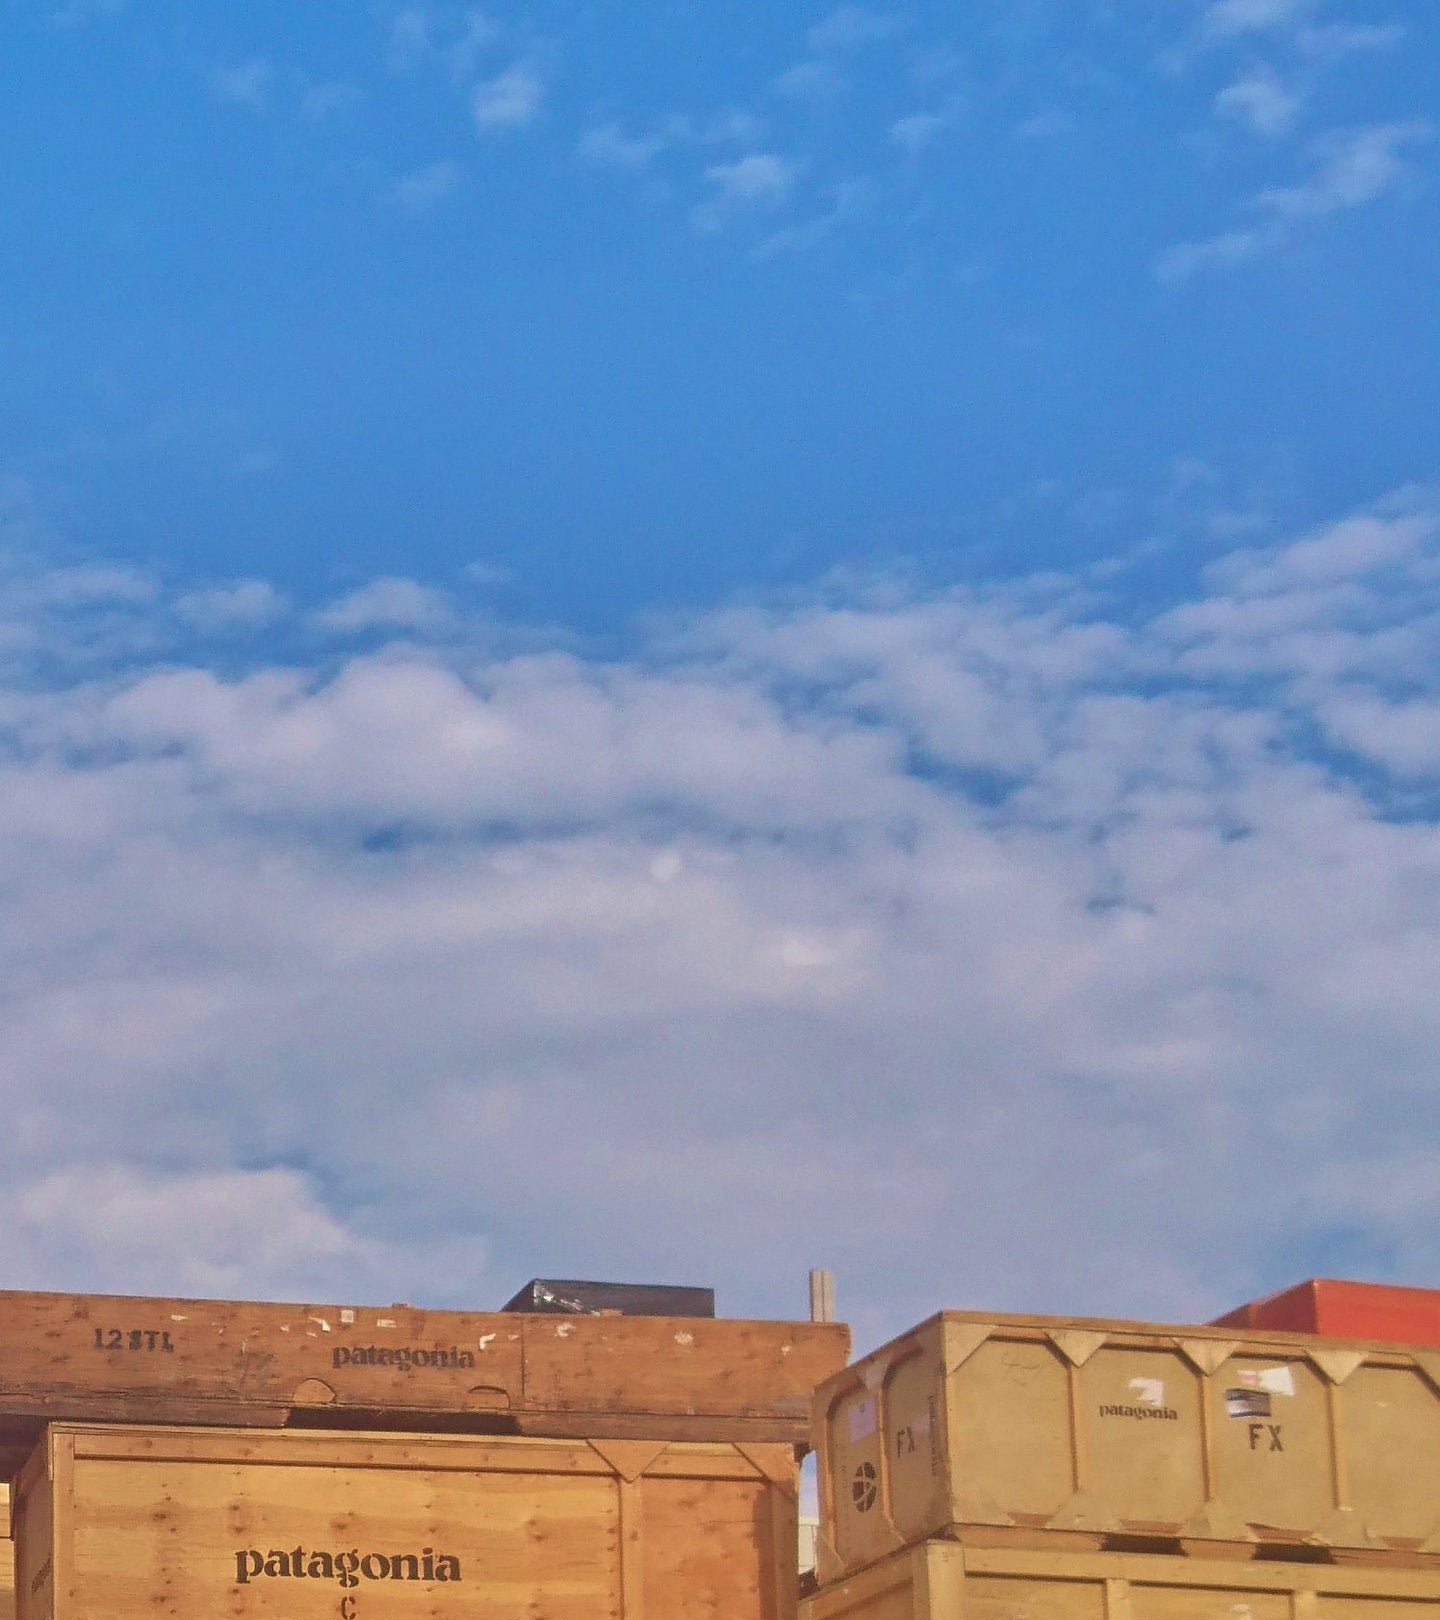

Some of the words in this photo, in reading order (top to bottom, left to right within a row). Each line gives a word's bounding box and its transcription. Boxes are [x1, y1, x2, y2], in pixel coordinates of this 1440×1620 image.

[332, 1344, 476, 1371] patagonia
[1099, 1404, 1178, 1421] patagonia
[235, 1546, 462, 1588] patagonia
[340, 1595, 357, 1620] C
